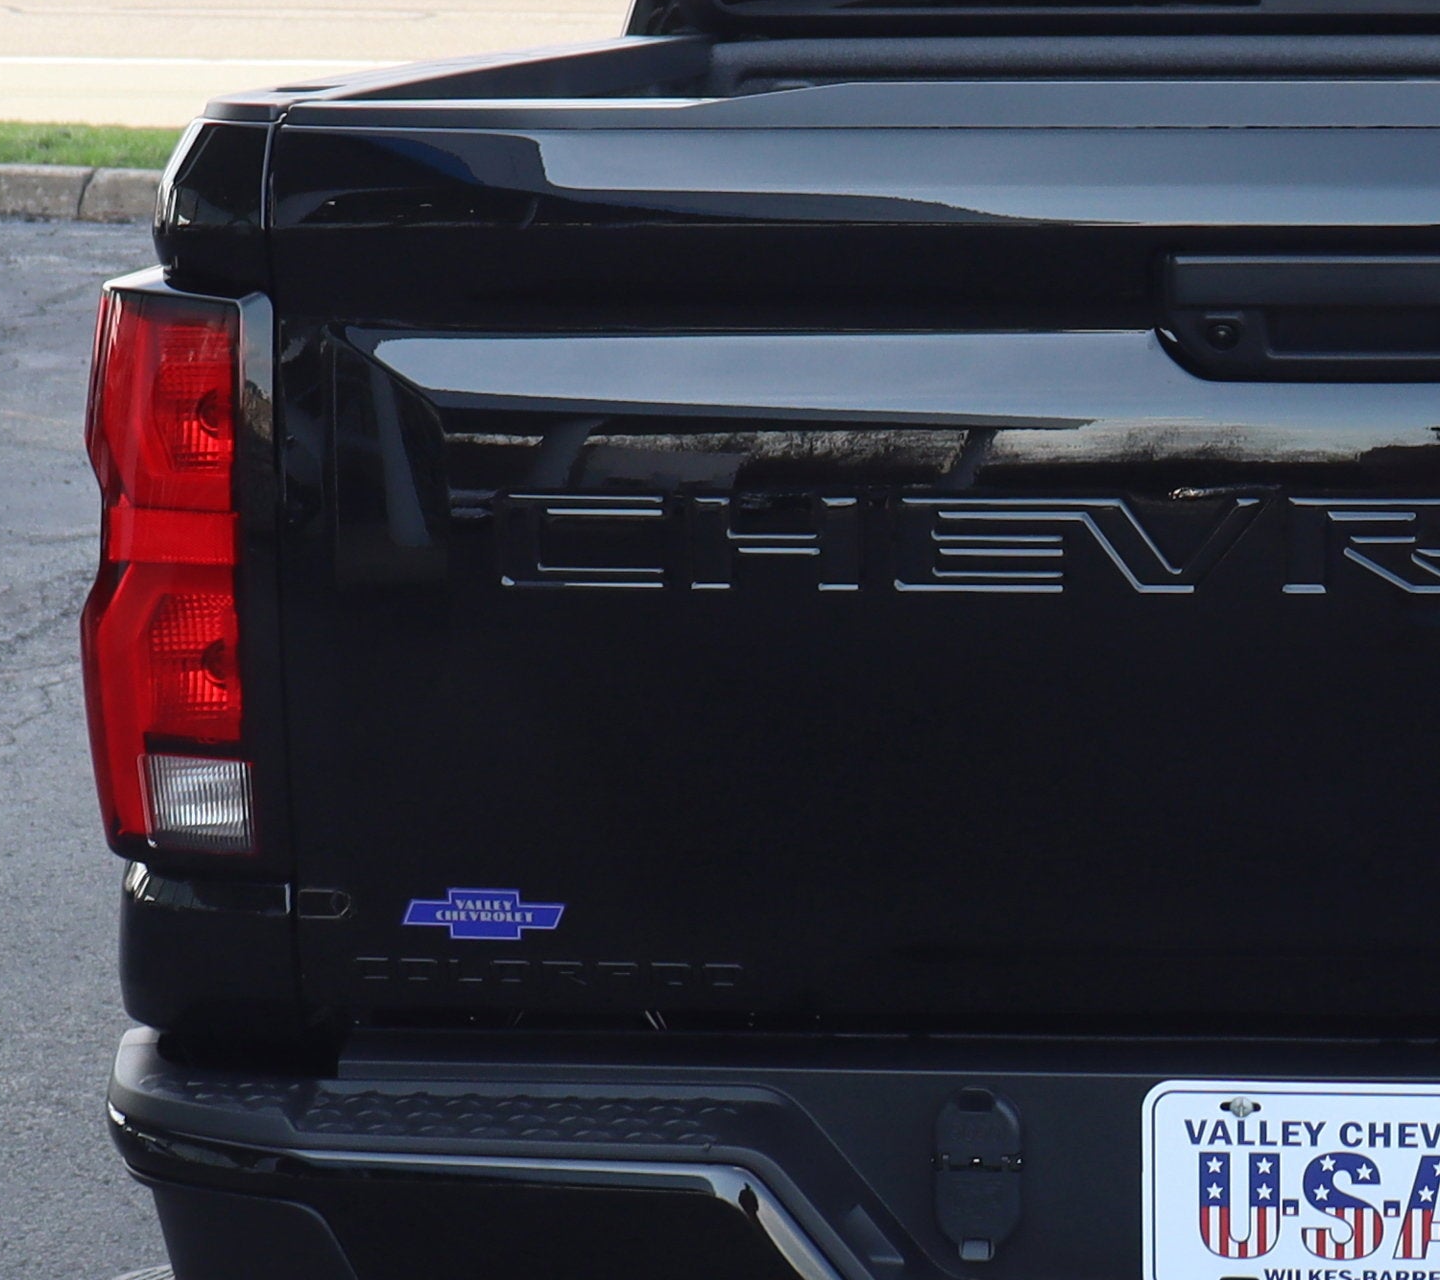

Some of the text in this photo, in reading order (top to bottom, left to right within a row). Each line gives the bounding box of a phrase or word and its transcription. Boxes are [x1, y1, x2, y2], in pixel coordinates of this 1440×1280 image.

[455, 899, 513, 911] VALLEY
[435, 910, 533, 923] CHEVROLET
[1184, 1119, 1327, 1147] VALLEY
